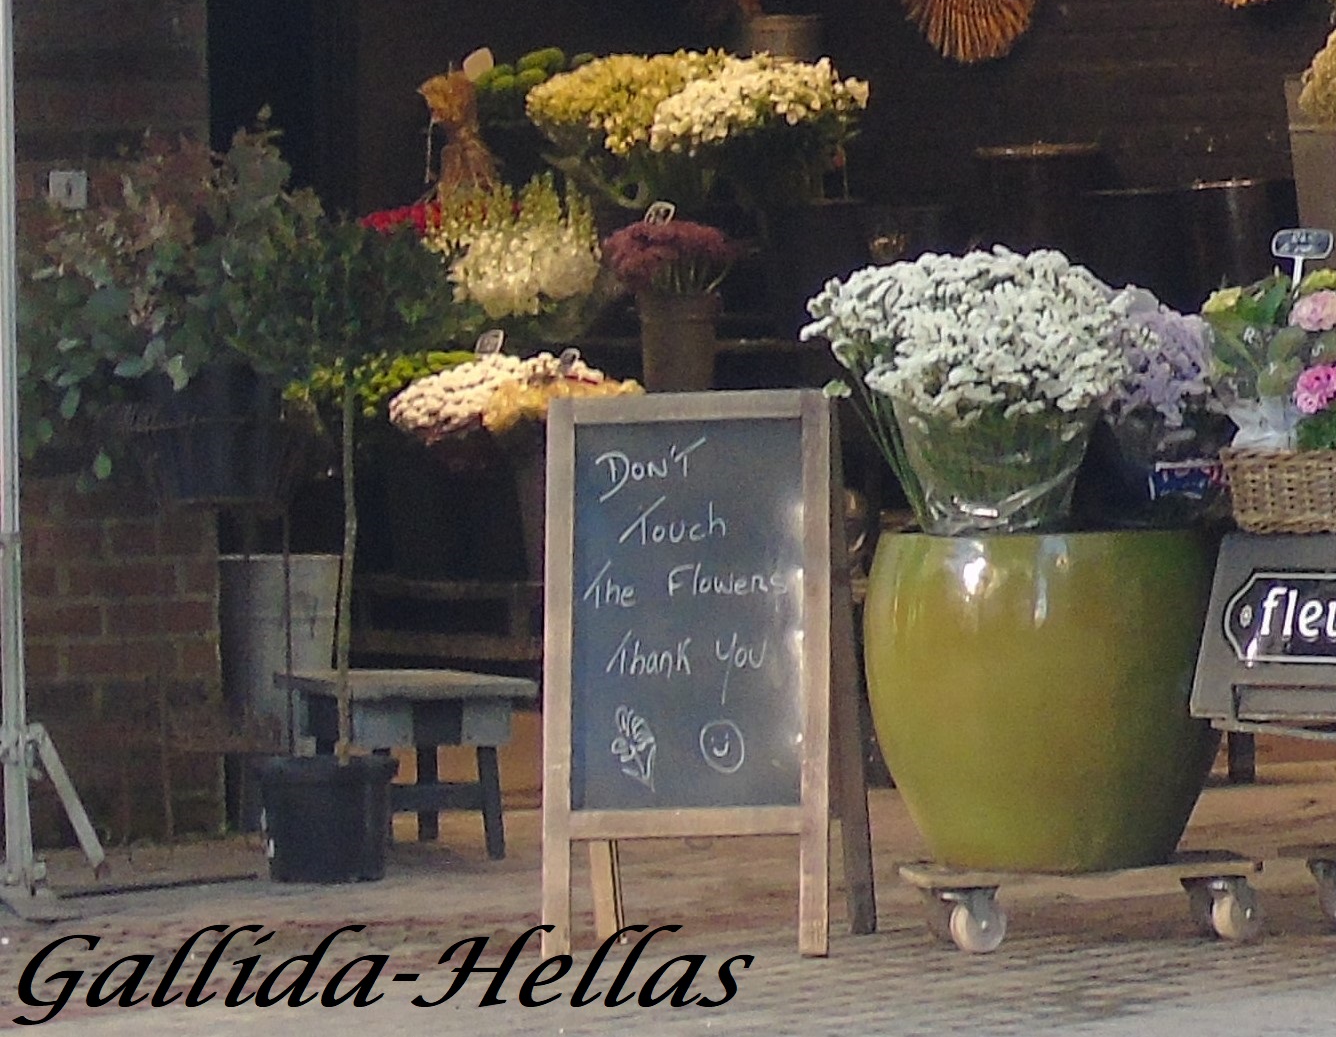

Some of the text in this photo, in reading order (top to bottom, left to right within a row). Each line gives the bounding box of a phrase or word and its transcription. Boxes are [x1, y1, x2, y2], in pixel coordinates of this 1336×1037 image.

[618, 495, 727, 545] Touch
[583, 561, 637, 609] The
[606, 629, 692, 679] Thank
